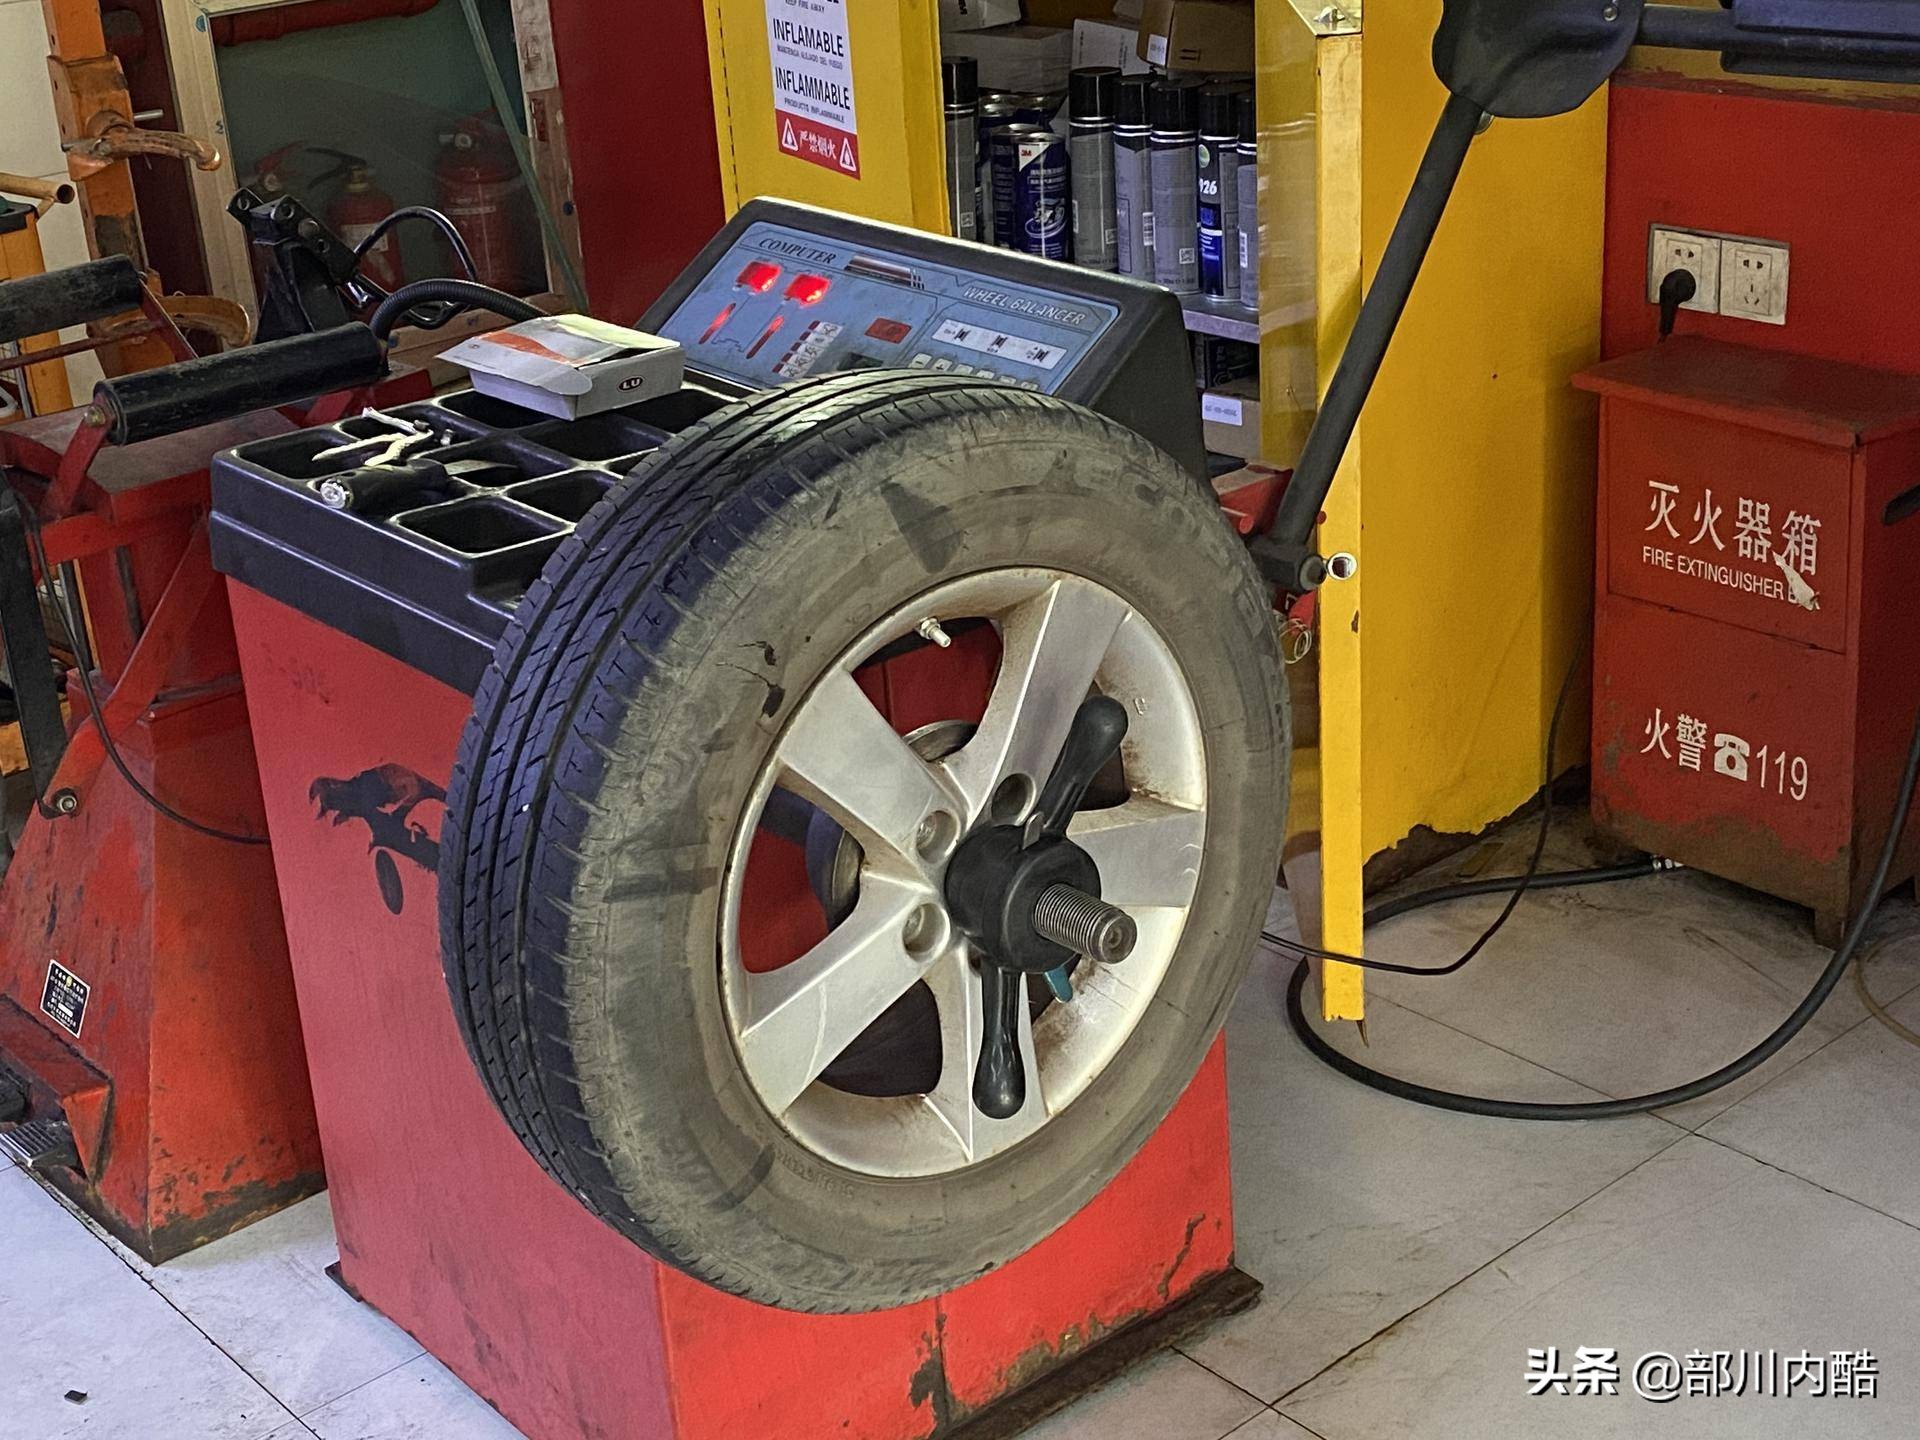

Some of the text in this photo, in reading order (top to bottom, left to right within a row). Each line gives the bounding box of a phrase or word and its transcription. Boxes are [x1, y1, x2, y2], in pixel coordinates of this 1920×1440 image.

[773, 18, 844, 57] INFLAMABLE
[775, 66, 850, 110] INFLAMMABLE
[1021, 149, 1032, 157] 3M
[759, 238, 837, 265] COMPUTER
[964, 287, 1086, 325] WHEEL BALANCER
[622, 377, 642, 390] LU
[1644, 480, 1822, 576] 灭火器箱
[1643, 546, 1674, 571] FIRE
[1677, 555, 1784, 600] EXTINGUISHER
[1640, 708, 1808, 801] 火警 119
